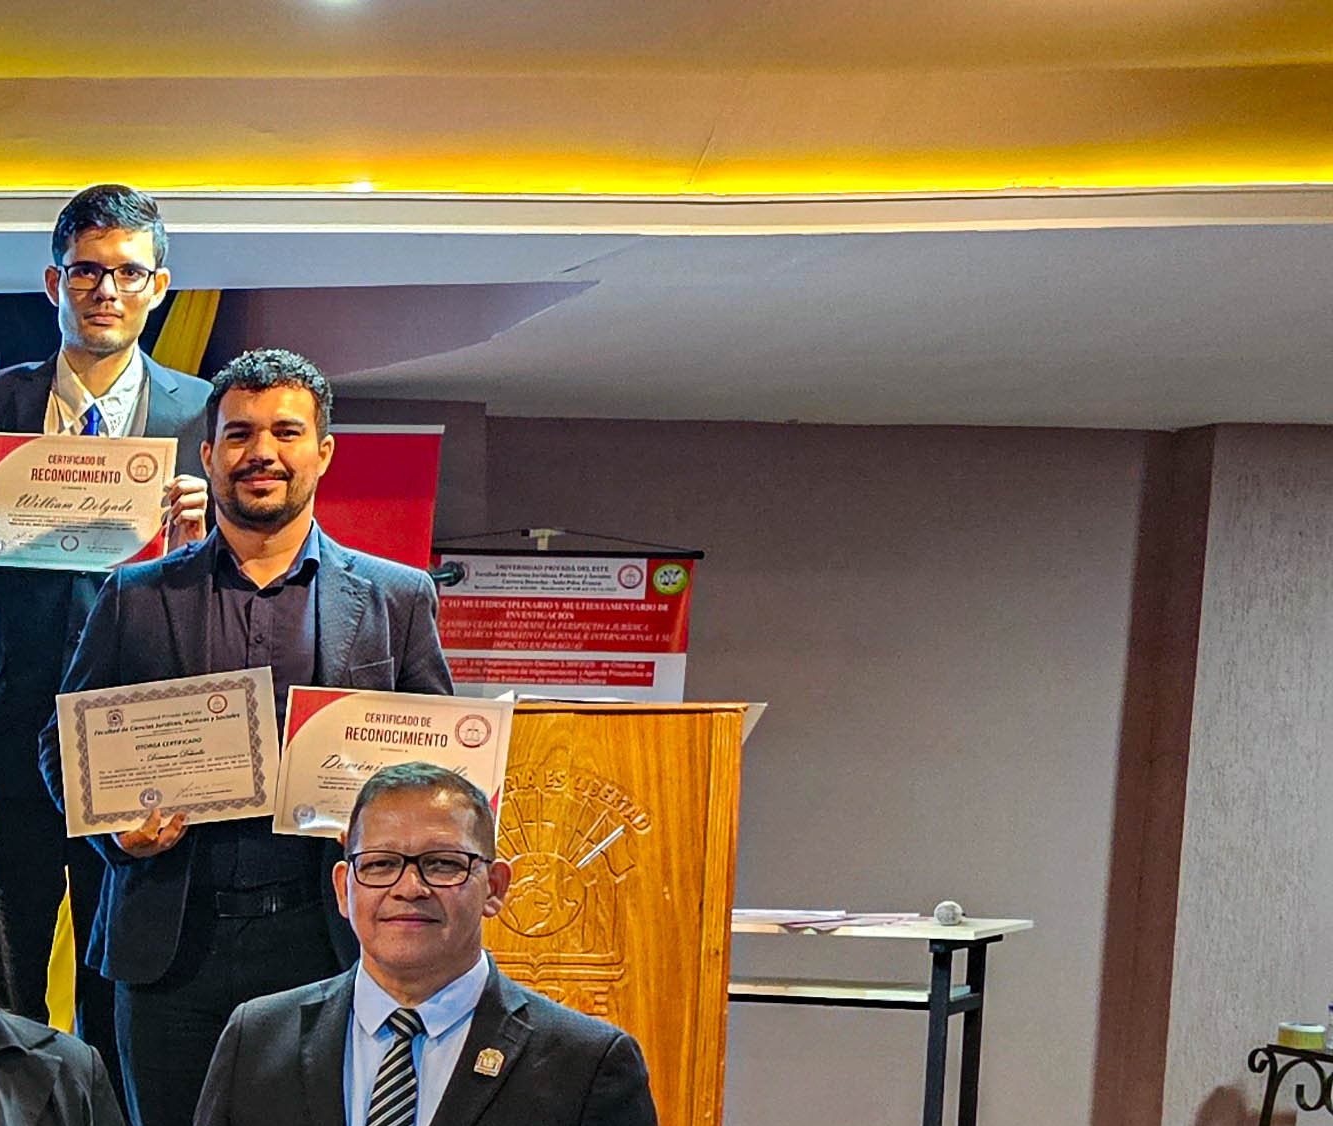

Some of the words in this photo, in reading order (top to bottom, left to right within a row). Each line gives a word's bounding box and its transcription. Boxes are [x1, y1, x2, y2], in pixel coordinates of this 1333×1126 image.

[48, 455, 95, 465] CERTIFICADO
[97, 456, 106, 466] DE
[31, 468, 121, 484] RECONOCIMIENTO
[15, 493, 73, 509] William
[78, 497, 134, 516] Delgado
[365, 713, 419, 726] CERTIFICADO
[421, 715, 432, 727] DE
[345, 726, 448, 748] RECONOCIMIENTO
[320, 754, 383, 771] Doméni
[544, 770, 568, 791] ES
[574, 775, 652, 835] LIBERTAD
